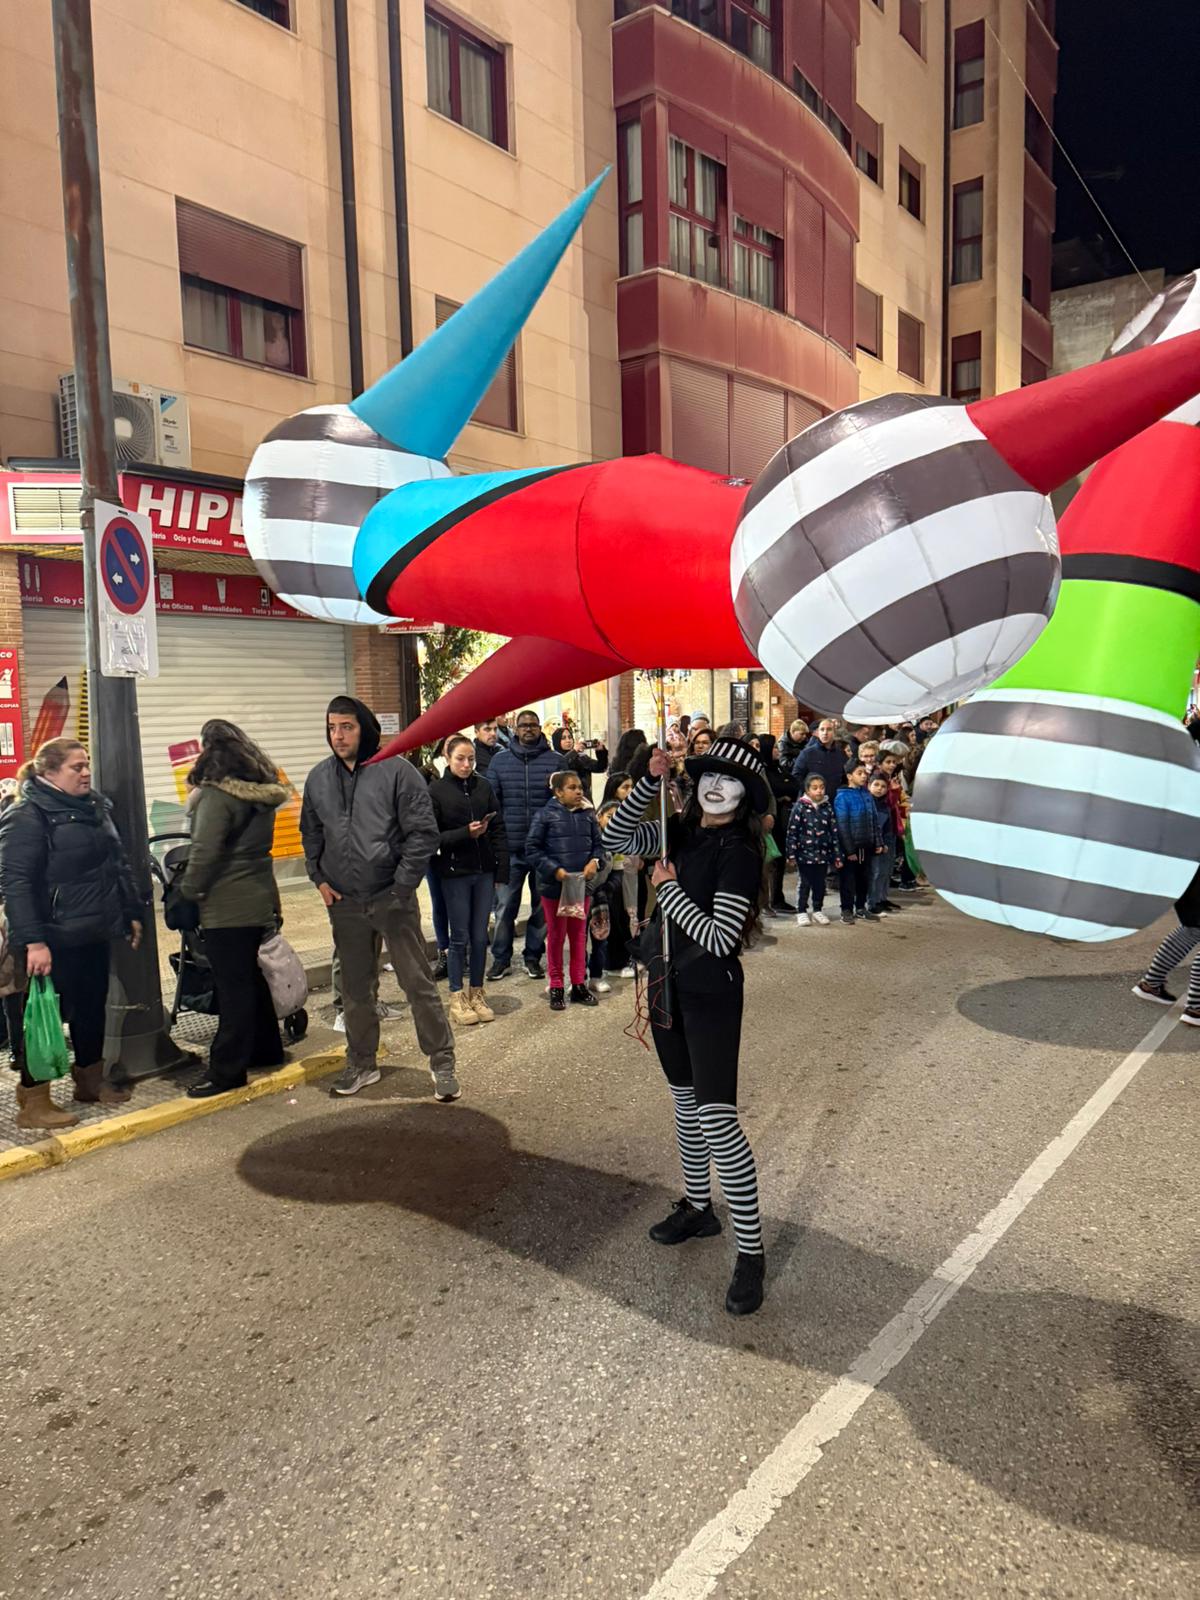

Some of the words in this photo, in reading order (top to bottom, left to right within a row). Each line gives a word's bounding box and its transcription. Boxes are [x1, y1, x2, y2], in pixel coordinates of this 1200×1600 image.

[173, 533, 187, 542] Ocio
[192, 535, 223, 546] Creatividad
[53, 596, 71, 604] Ocio
[71, 598, 77, 606] y
[171, 602, 194, 611] Oficina
